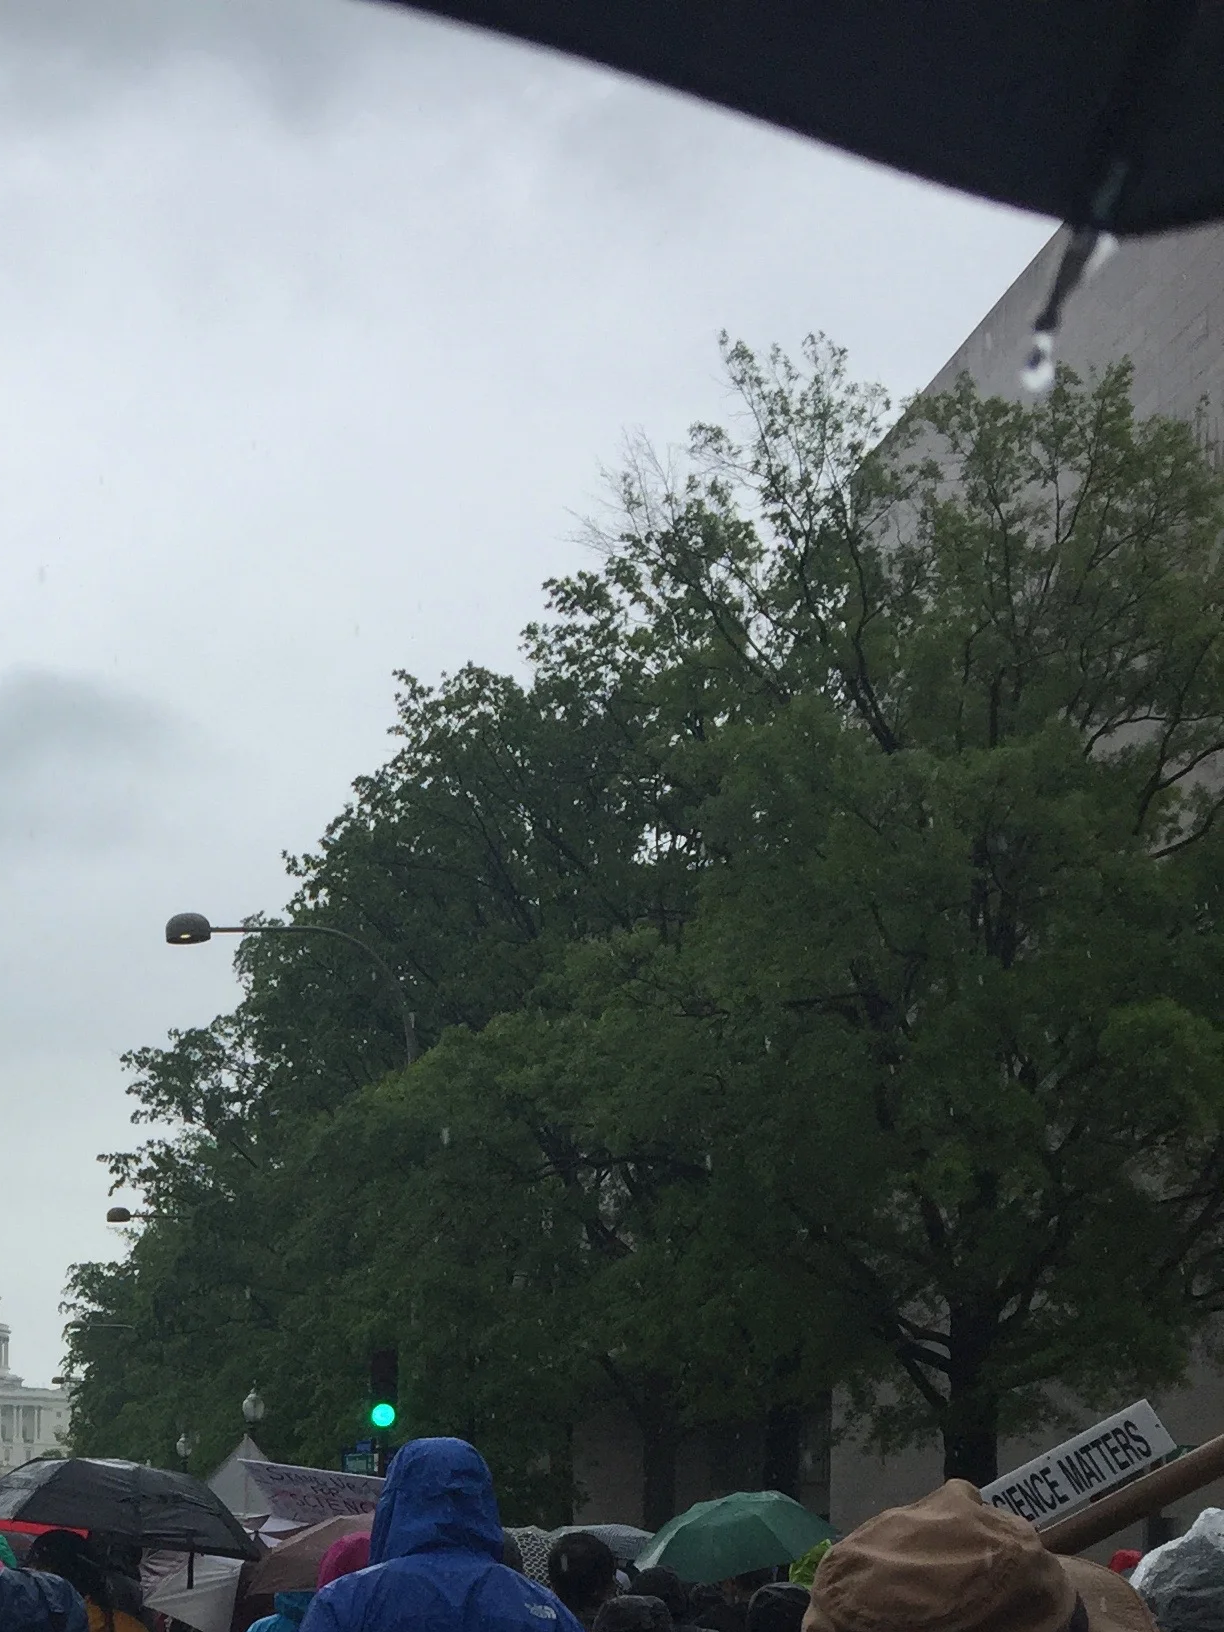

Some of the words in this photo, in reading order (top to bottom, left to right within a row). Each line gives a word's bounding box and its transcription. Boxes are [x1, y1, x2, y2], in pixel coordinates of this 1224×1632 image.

[980, 1466, 1070, 1522] CIENCE
[1057, 1421, 1152, 1495] MATTERS
[289, 1492, 376, 1514] SCIENC
